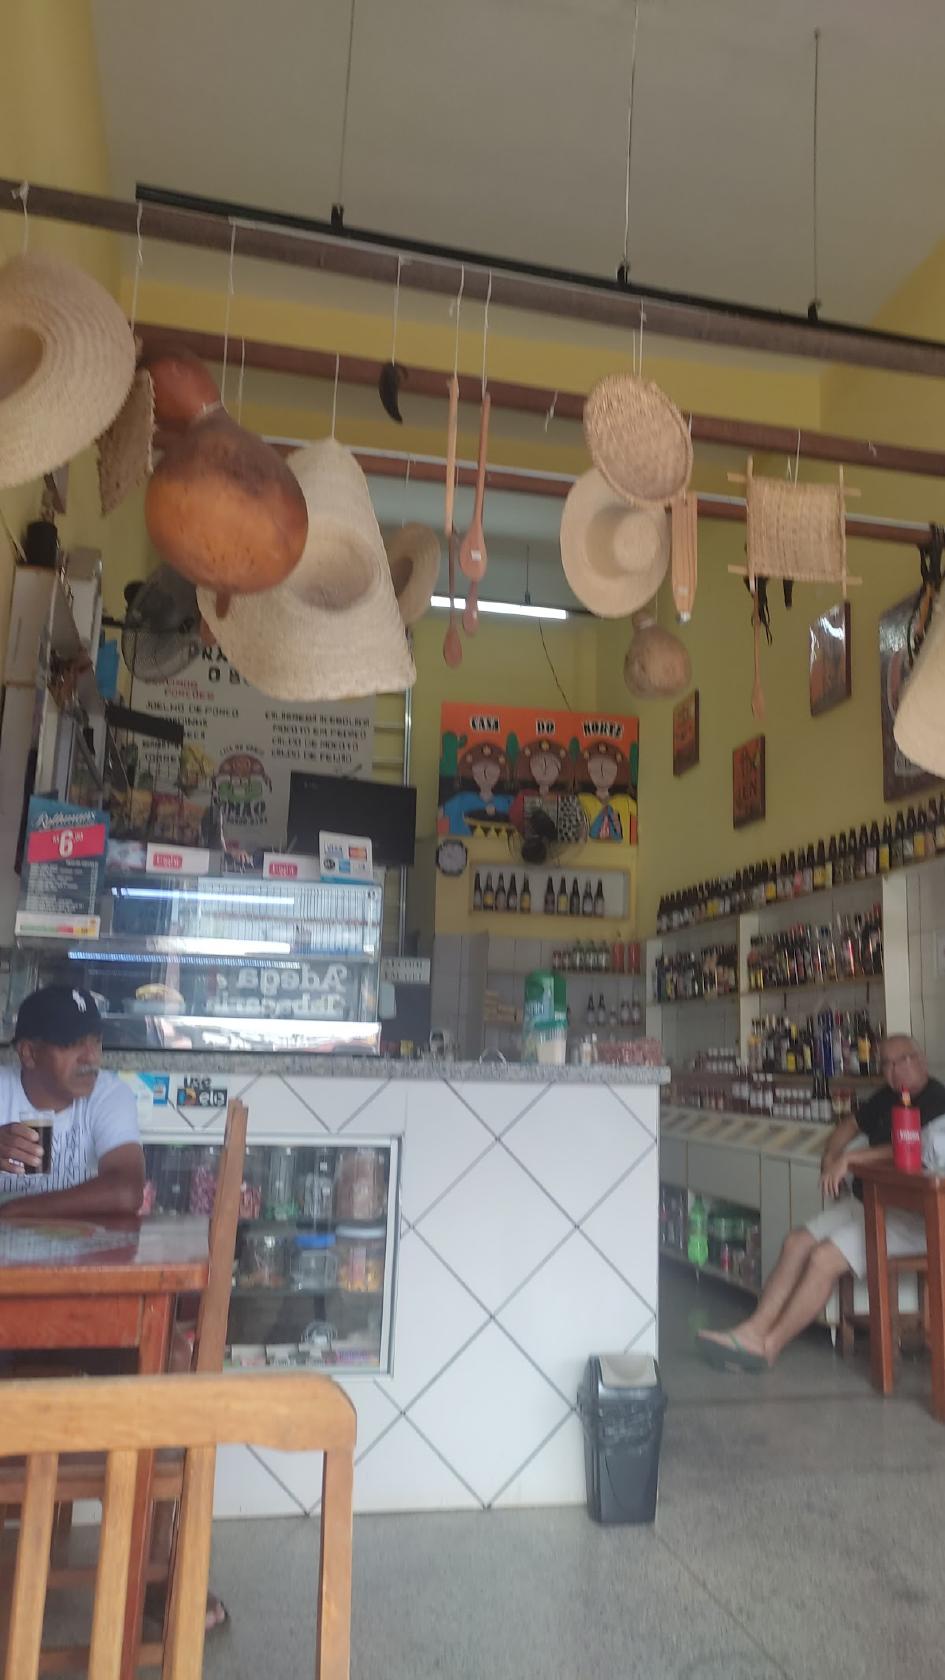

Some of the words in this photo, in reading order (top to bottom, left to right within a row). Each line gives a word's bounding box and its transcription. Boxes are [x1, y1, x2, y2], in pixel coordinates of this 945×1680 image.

[471, 716, 500, 732] CASA
[536, 719, 556, 735] DO
[583, 721, 623, 738] NORTE
[184, 1076, 211, 1089] use
